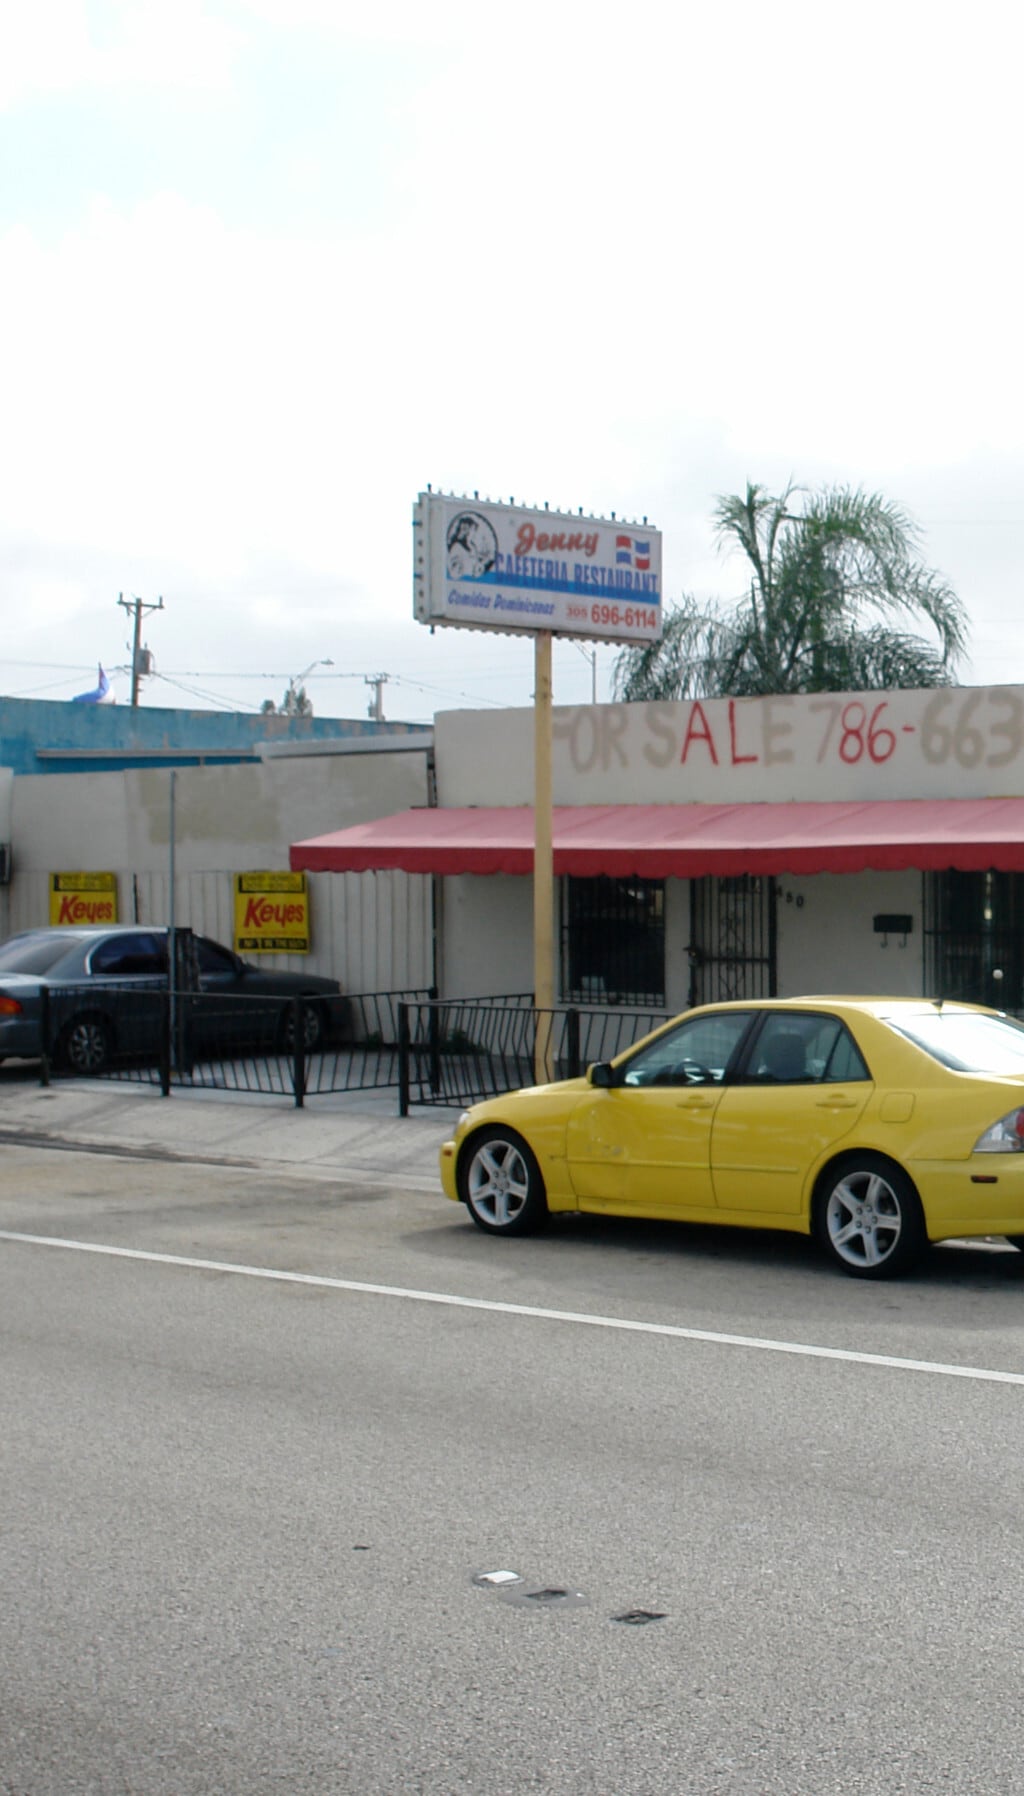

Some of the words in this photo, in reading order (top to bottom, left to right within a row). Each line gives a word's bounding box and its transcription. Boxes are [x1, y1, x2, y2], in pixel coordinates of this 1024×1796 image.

[514, 523, 599, 557] Jenny
[496, 552, 569, 591] CAFETERIA
[574, 562, 658, 602] RESTAURANT
[591, 603, 656, 628] 696-6114
[643, 698, 796, 769] SALE
[58, 896, 113, 923] Keyes
[243, 897, 305, 928] Keyes
